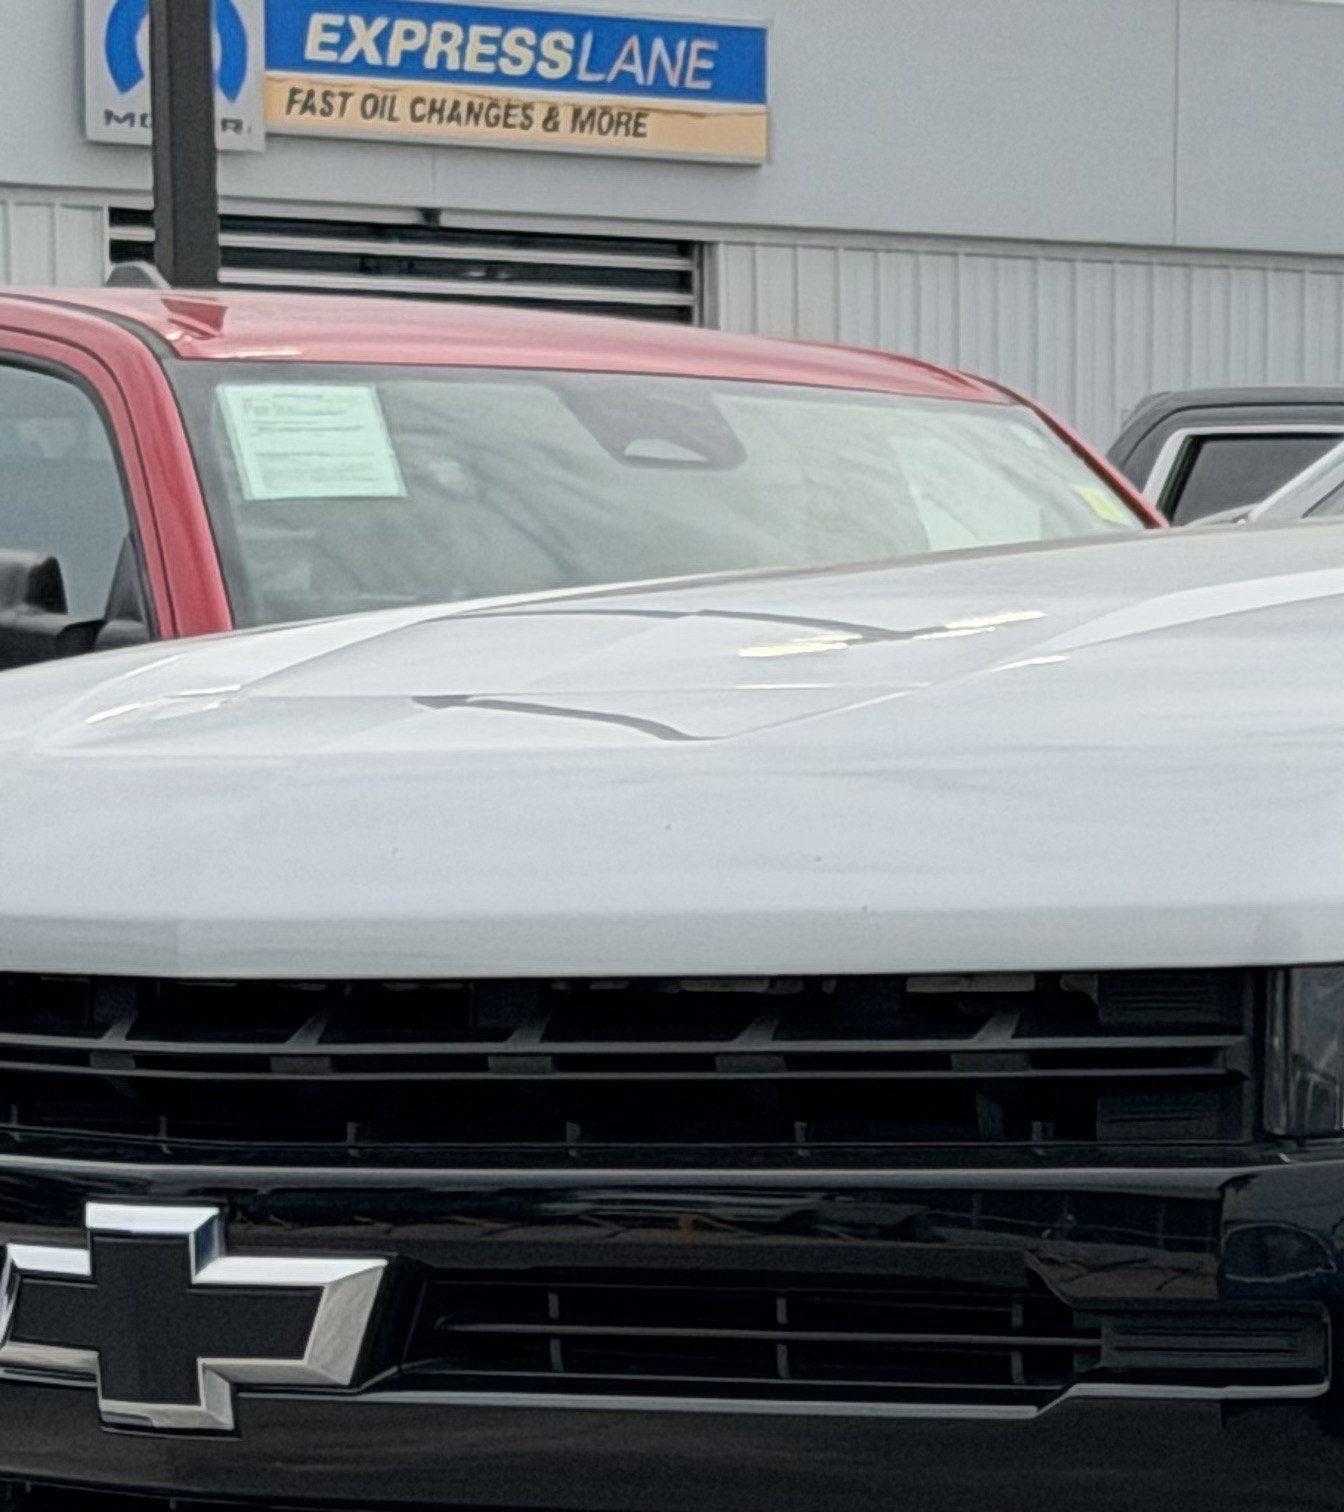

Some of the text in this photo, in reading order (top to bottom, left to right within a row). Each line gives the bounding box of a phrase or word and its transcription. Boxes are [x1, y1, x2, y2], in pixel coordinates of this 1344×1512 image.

[285, 86, 648, 138] FAST OIL CHANGES & MORE
